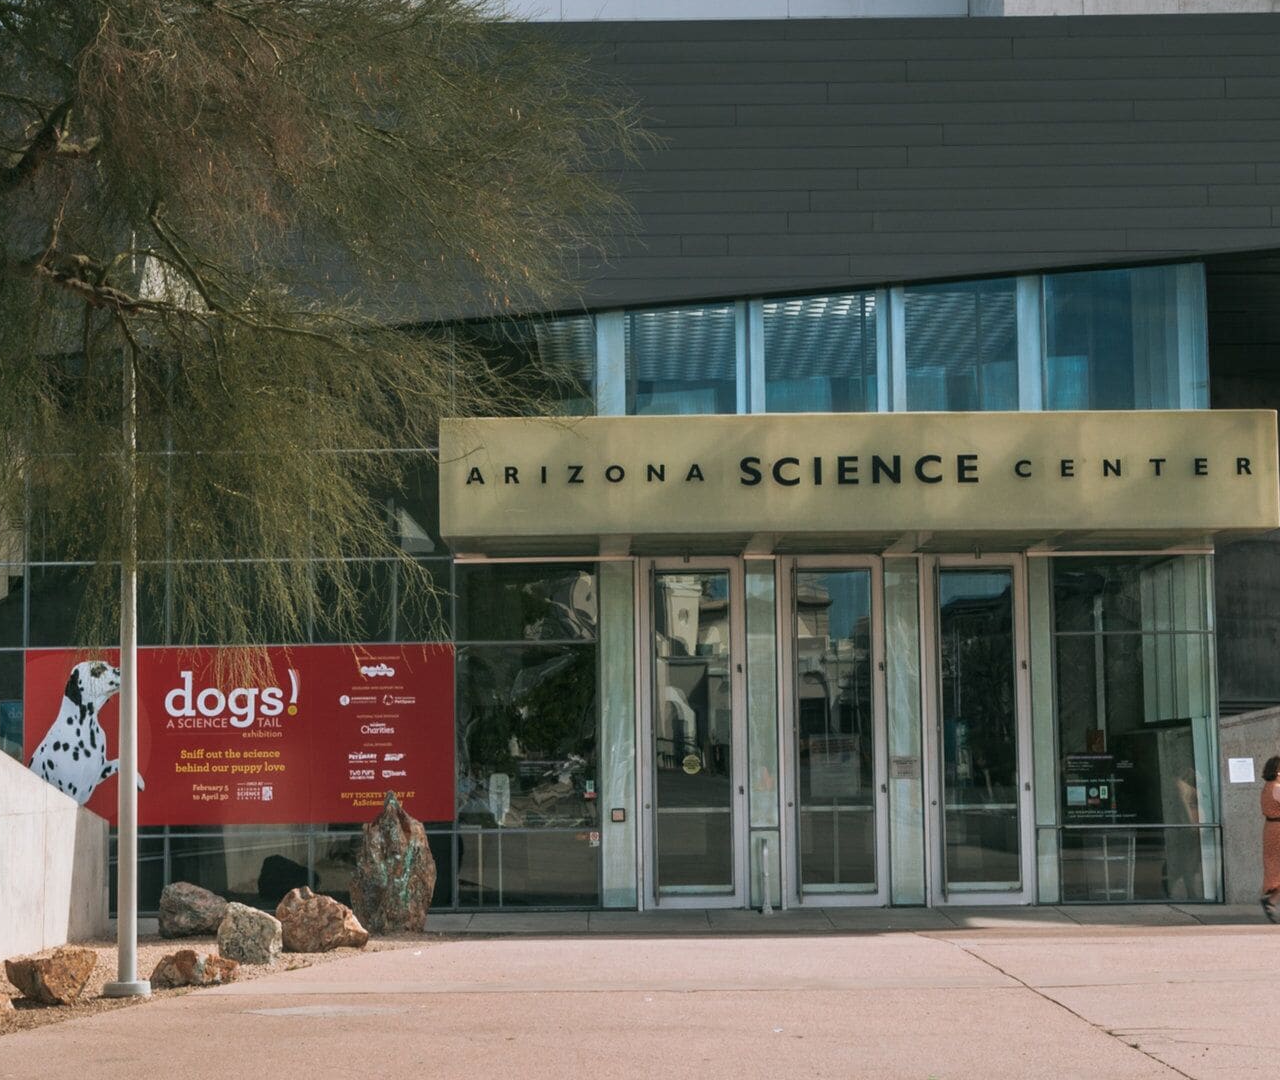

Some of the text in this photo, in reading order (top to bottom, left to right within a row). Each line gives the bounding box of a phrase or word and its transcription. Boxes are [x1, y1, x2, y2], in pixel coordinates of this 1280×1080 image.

[466, 454, 1252, 486] ARIZONA SCIENCE CENTER
[164, 668, 300, 728] dogs!
[166, 717, 282, 729] A SCIENCE TAIL
[242, 729, 283, 738] exhibition
[360, 724, 395, 734] Charities
[180, 749, 281, 759] Sniff out the science
[175, 761, 286, 774] behind our puppy love
[192, 784, 223, 792] February
[201, 792, 219, 801] April
